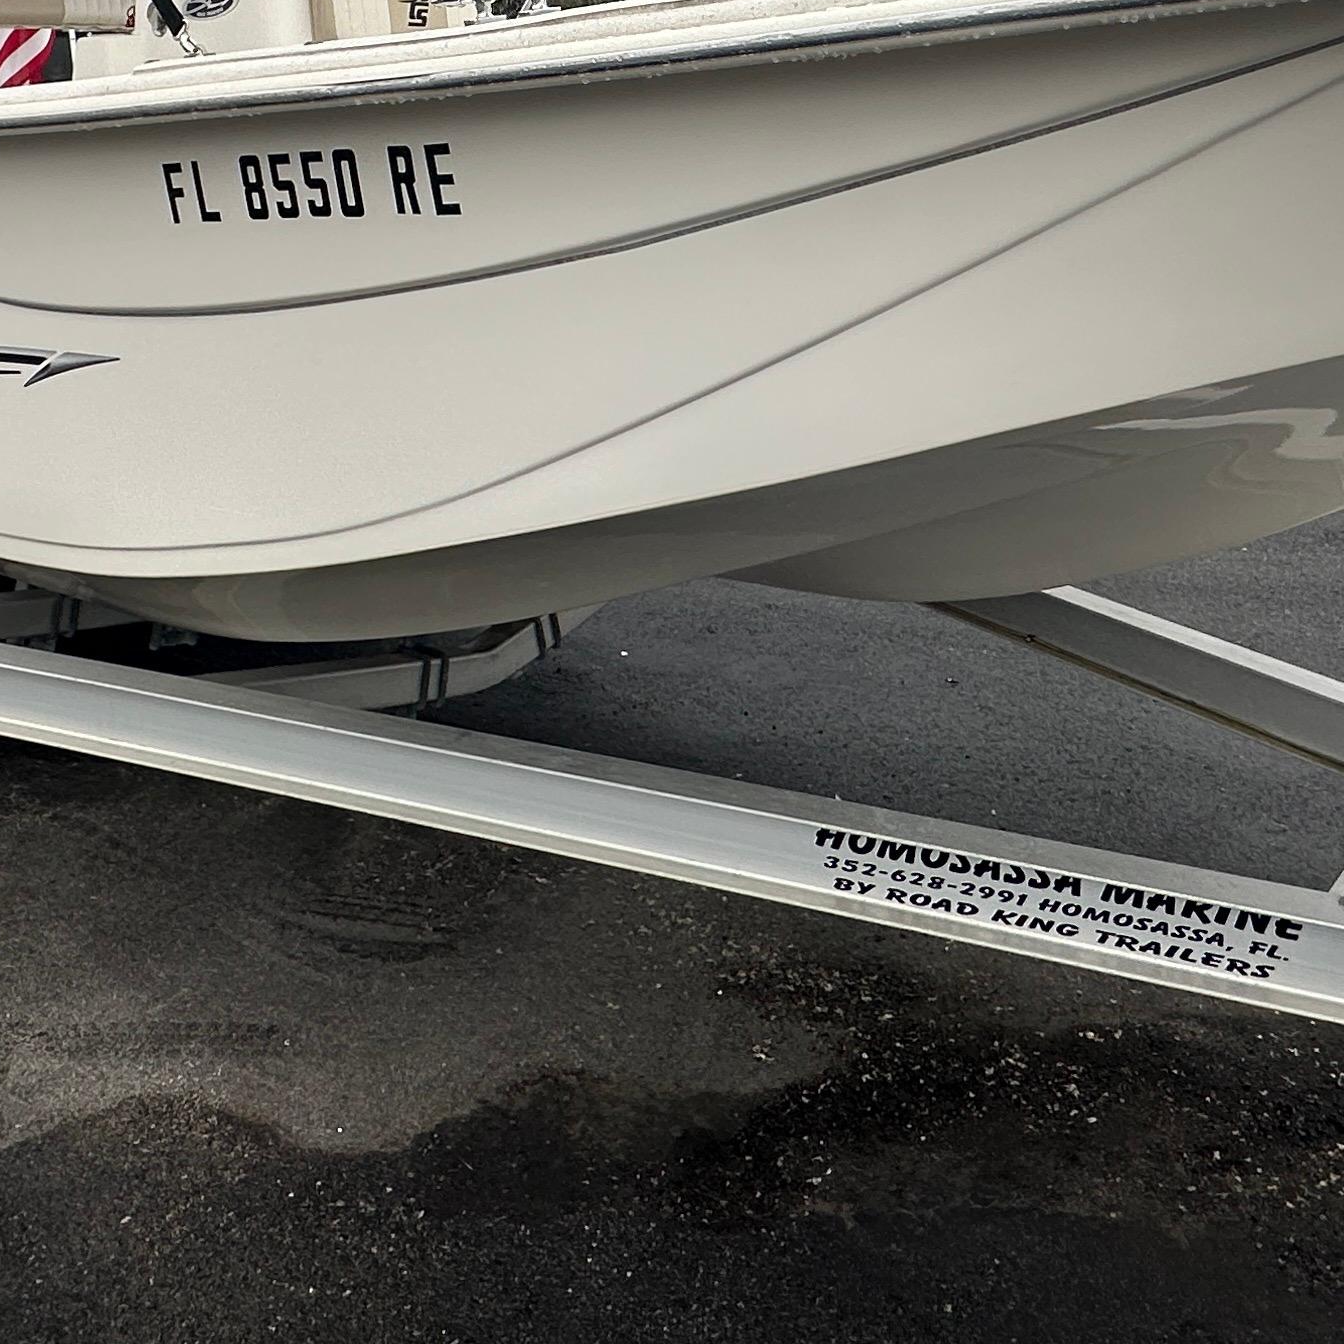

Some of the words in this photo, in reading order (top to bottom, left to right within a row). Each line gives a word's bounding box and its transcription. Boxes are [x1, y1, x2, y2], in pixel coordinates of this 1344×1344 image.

[161, 159, 222, 224] FL
[238, 147, 366, 221] 8550
[386, 142, 463, 217] RE
[815, 827, 1082, 897] HOMOSASSA
[1100, 883, 1304, 942] MARINE
[823, 856, 1029, 907] 352-628-2991
[1038, 898, 1234, 952] HOMOSASSA,
[1248, 940, 1289, 962] FL.
[833, 877, 876, 895] BY
[885, 887, 980, 916] ROAD
[991, 909, 1080, 938] KING
[1095, 929, 1276, 979] TRAILERS
